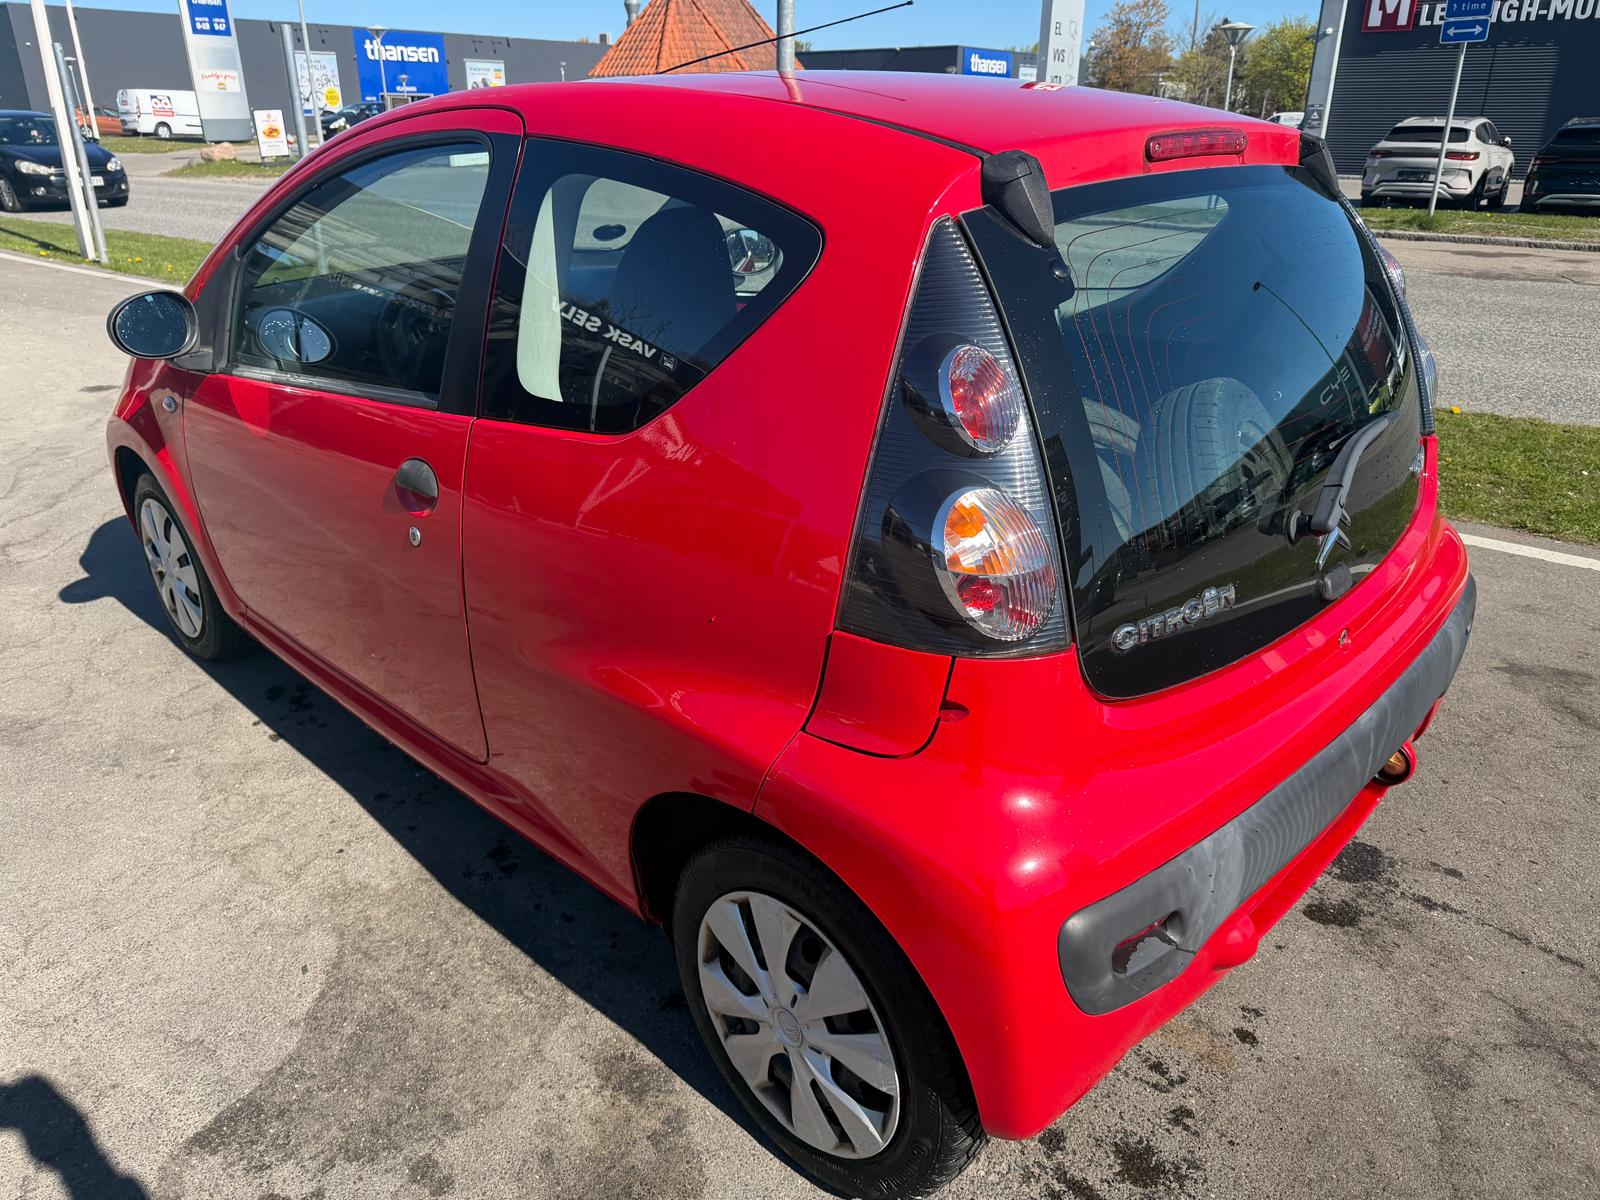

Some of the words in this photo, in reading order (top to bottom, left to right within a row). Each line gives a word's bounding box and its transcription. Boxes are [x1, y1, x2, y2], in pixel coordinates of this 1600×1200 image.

[1462, 2, 1487, 11] time
[1055, 21, 1062, 36] EL
[364, 39, 439, 63] thansen
[970, 53, 1007, 75] thansen
[1110, 583, 1236, 654] CITROËN
